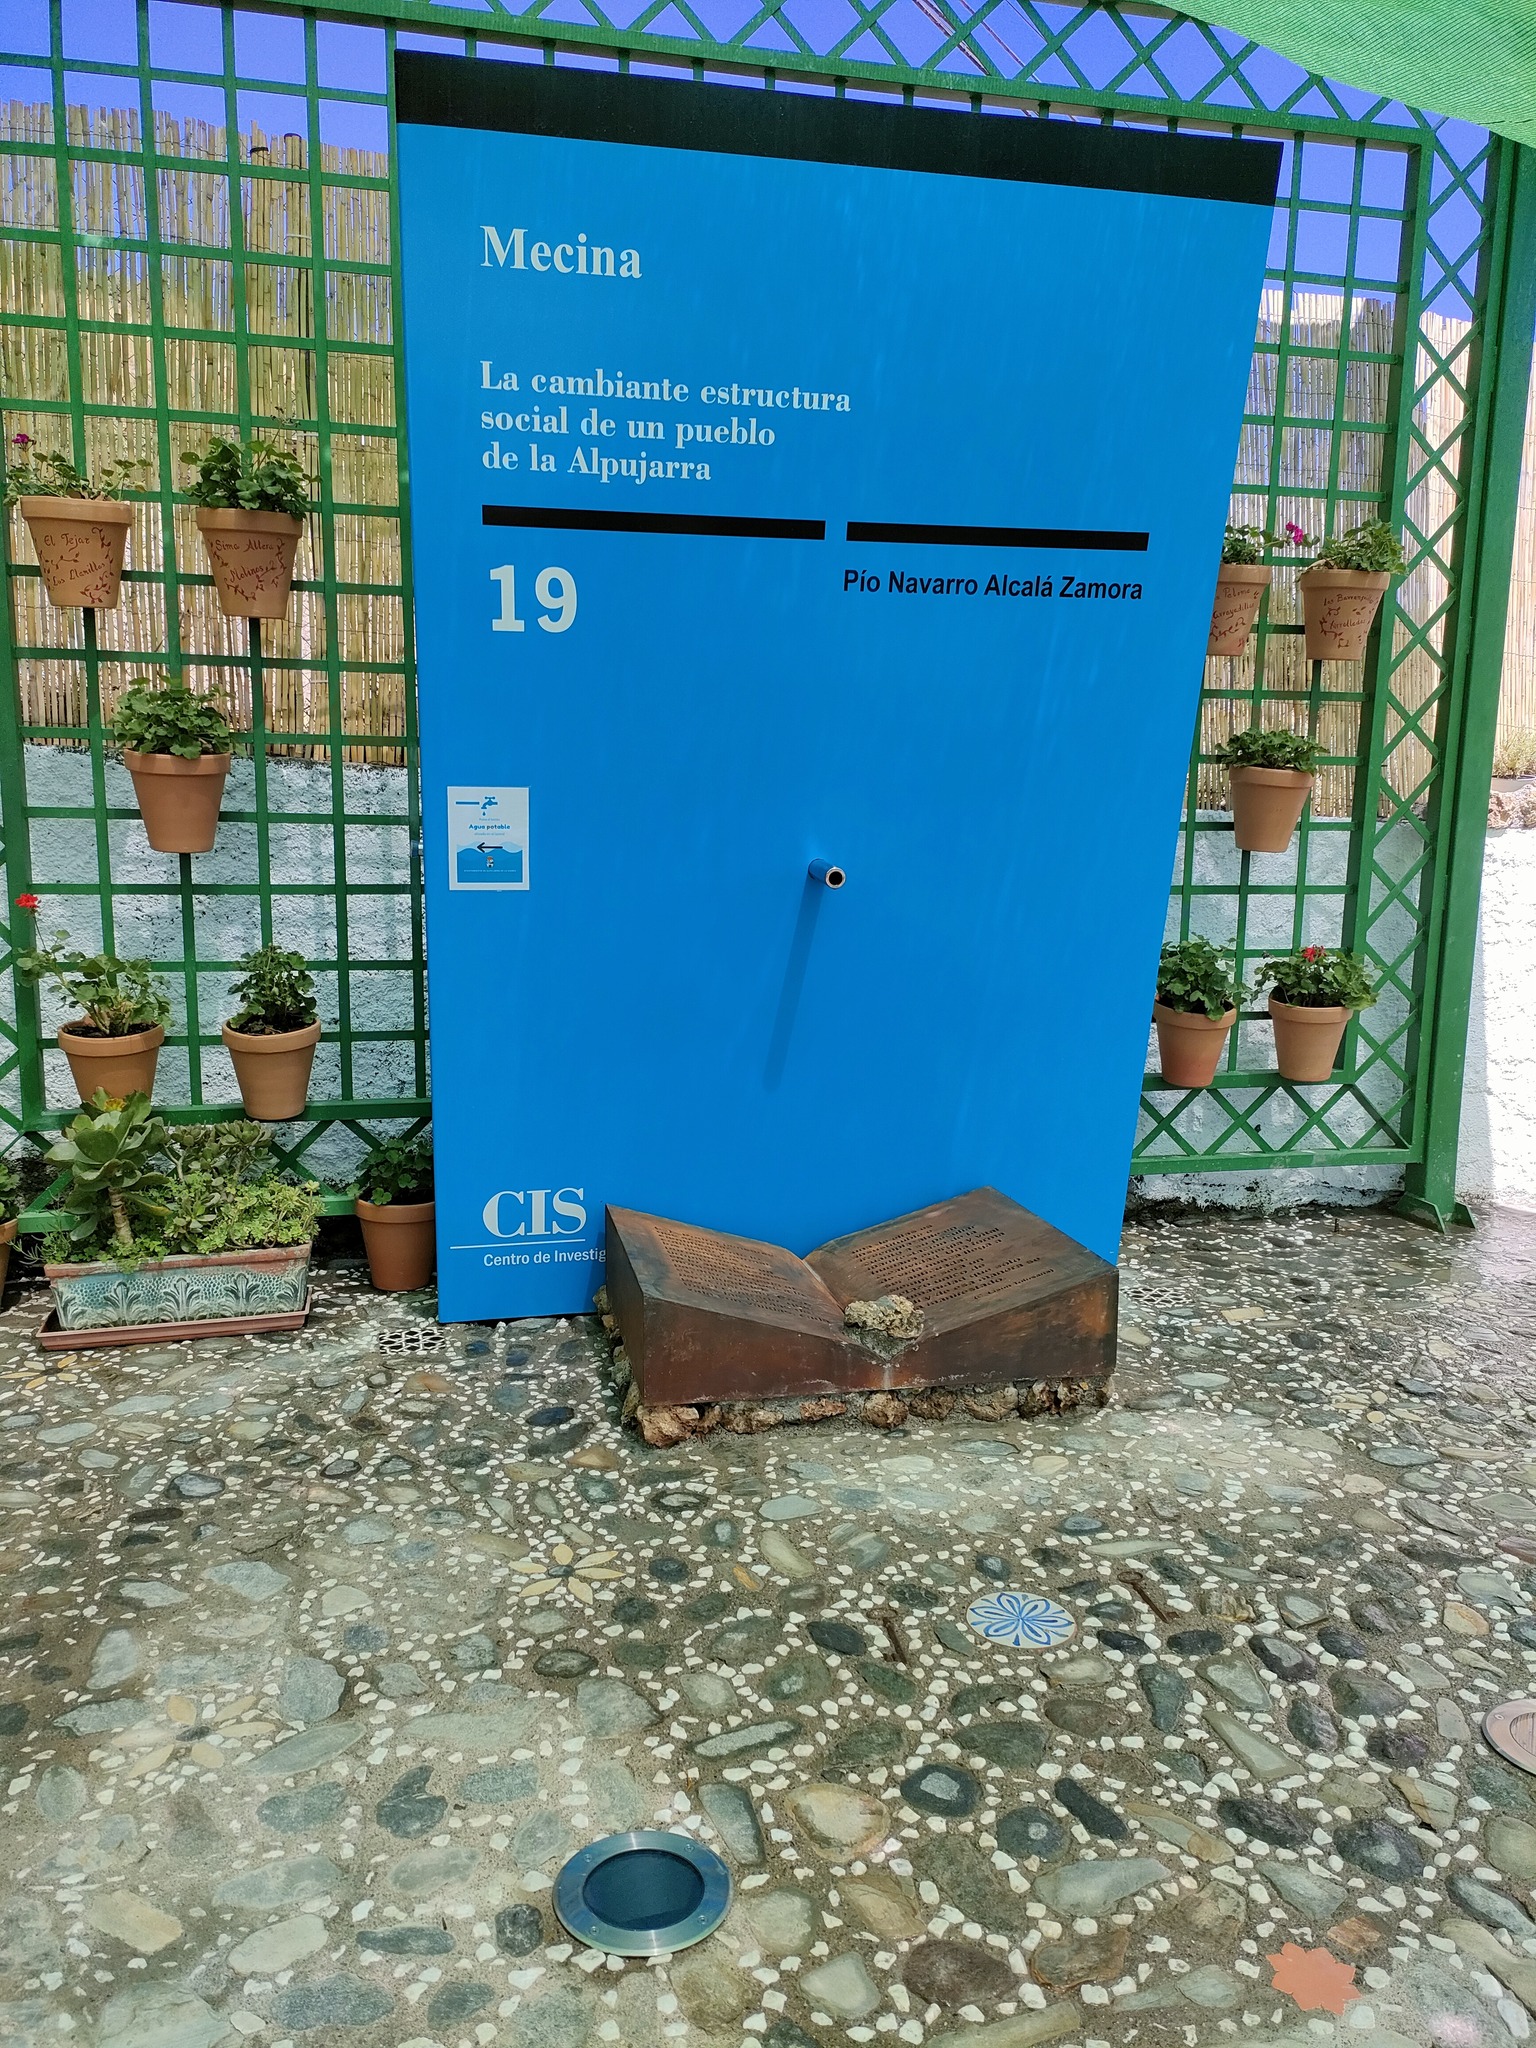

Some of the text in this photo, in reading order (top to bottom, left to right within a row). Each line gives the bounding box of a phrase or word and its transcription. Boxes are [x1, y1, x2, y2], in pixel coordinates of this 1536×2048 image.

[480, 226, 642, 278] Mecina
[481, 361, 850, 411] La cambiante estructura
[482, 406, 775, 448] social de un pueblo
[483, 442, 711, 484] de la Alpujarra
[44, 533, 91, 552] El Tejar
[490, 565, 577, 632] 19
[844, 570, 1142, 599] Pío Navarro Alcalá Zamora
[483, 1188, 586, 1237] CIS
[484, 1254, 529, 1266] Centro
[534, 1252, 550, 1263] de
